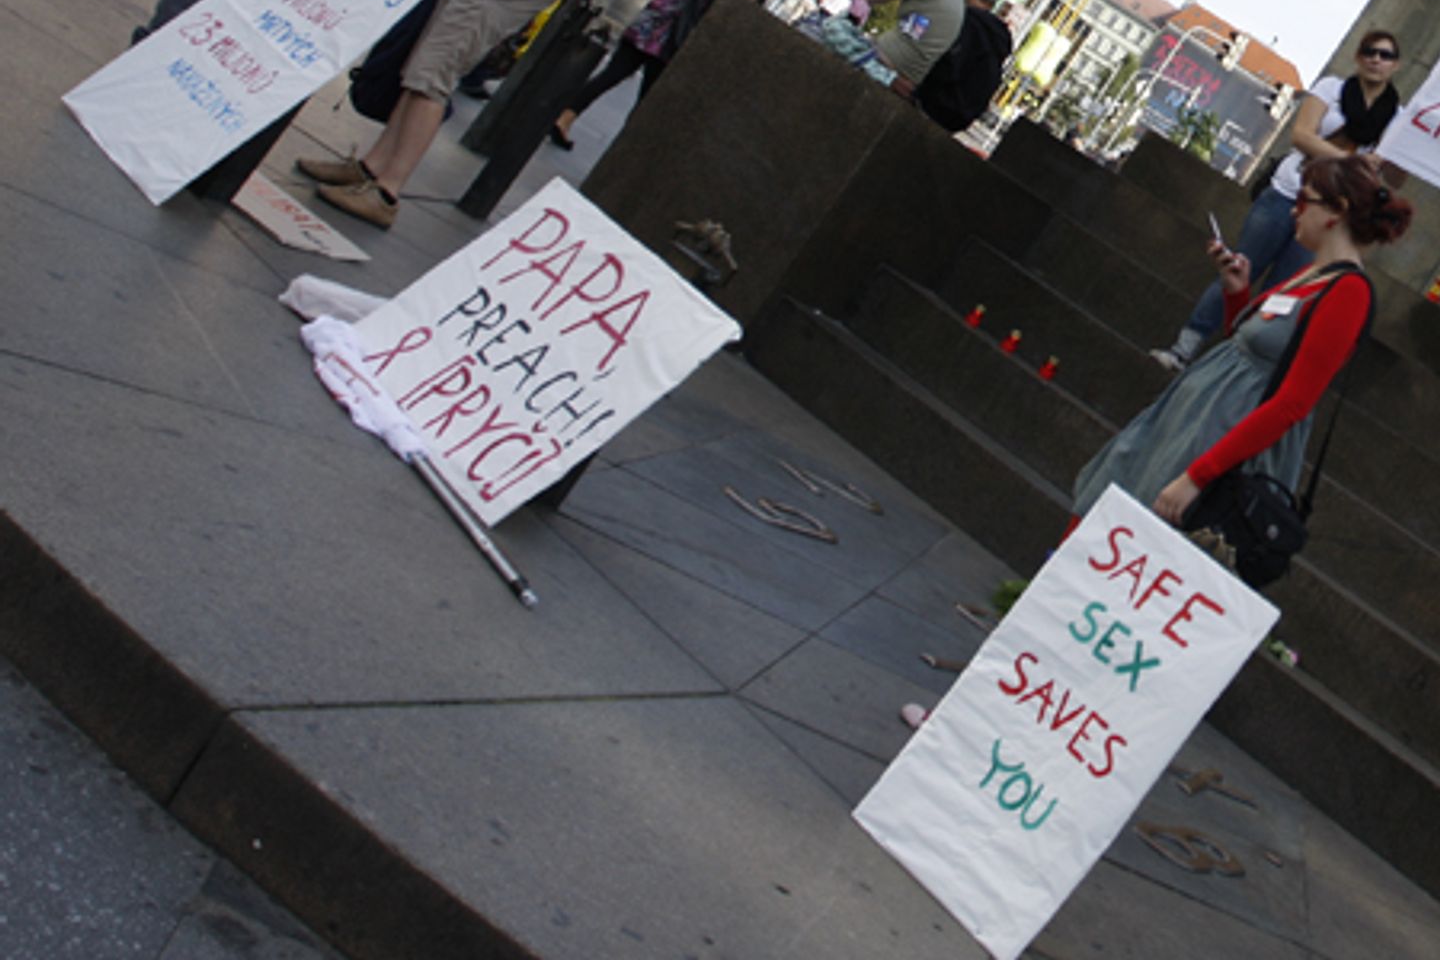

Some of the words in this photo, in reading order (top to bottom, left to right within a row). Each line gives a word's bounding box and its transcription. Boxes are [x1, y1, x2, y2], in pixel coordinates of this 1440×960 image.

[178, 12, 223, 47] 23
[480, 207, 651, 371] PAPA
[1088, 526, 1226, 648] SAFE
[1068, 601, 1160, 692] SEX
[997, 652, 1128, 778] SAVES
[979, 739, 1058, 831] YOU
